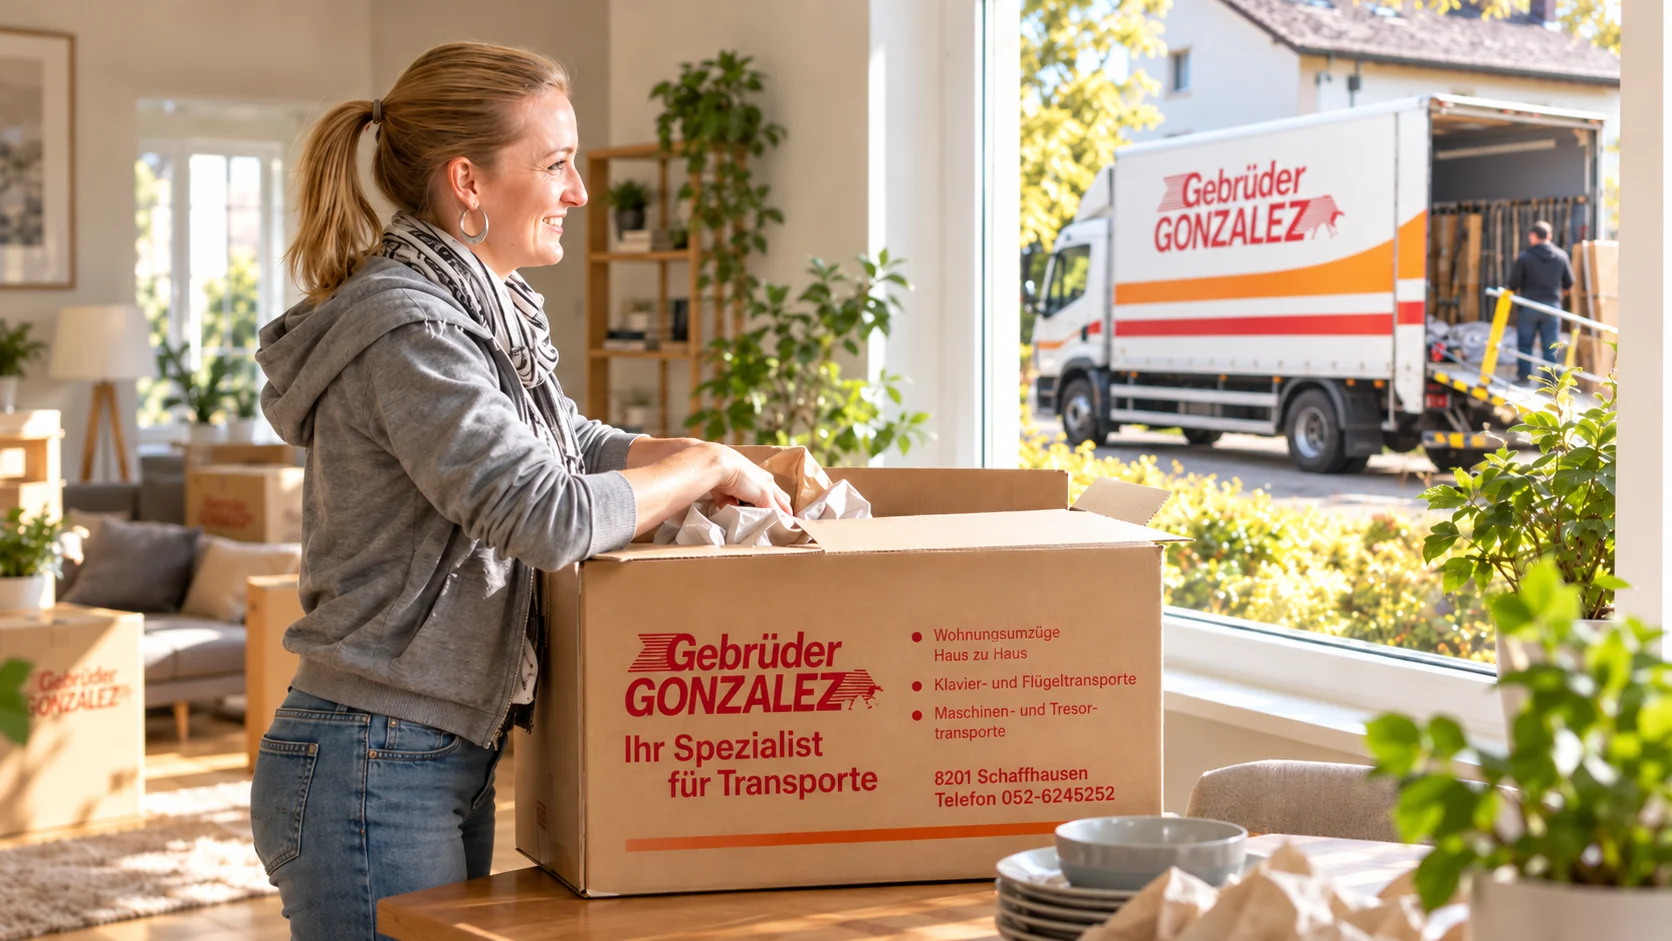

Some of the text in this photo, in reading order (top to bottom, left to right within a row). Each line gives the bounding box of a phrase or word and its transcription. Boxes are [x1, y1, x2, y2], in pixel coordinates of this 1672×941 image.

[1182, 160, 1307, 208] Gebrüder
[1154, 199, 1312, 253] GONZALEZ
[933, 625, 1061, 643] Wohnungsumzüge
[666, 631, 842, 672] Gebrüder
[933, 647, 1028, 662] Haus zu Haus
[934, 672, 1137, 691] Klavier- und Flügeltransporte
[625, 671, 848, 717] GONZALEZ
[934, 701, 1098, 720] Maschinen- und Tresor-
[934, 725, 1006, 741] transporte
[625, 730, 824, 768] Ihr Spezialist
[668, 767, 878, 800] für Transporte
[934, 766, 1088, 786] 8201 Schaffhausen
[934, 785, 1116, 808] Telefon 052-6245252
